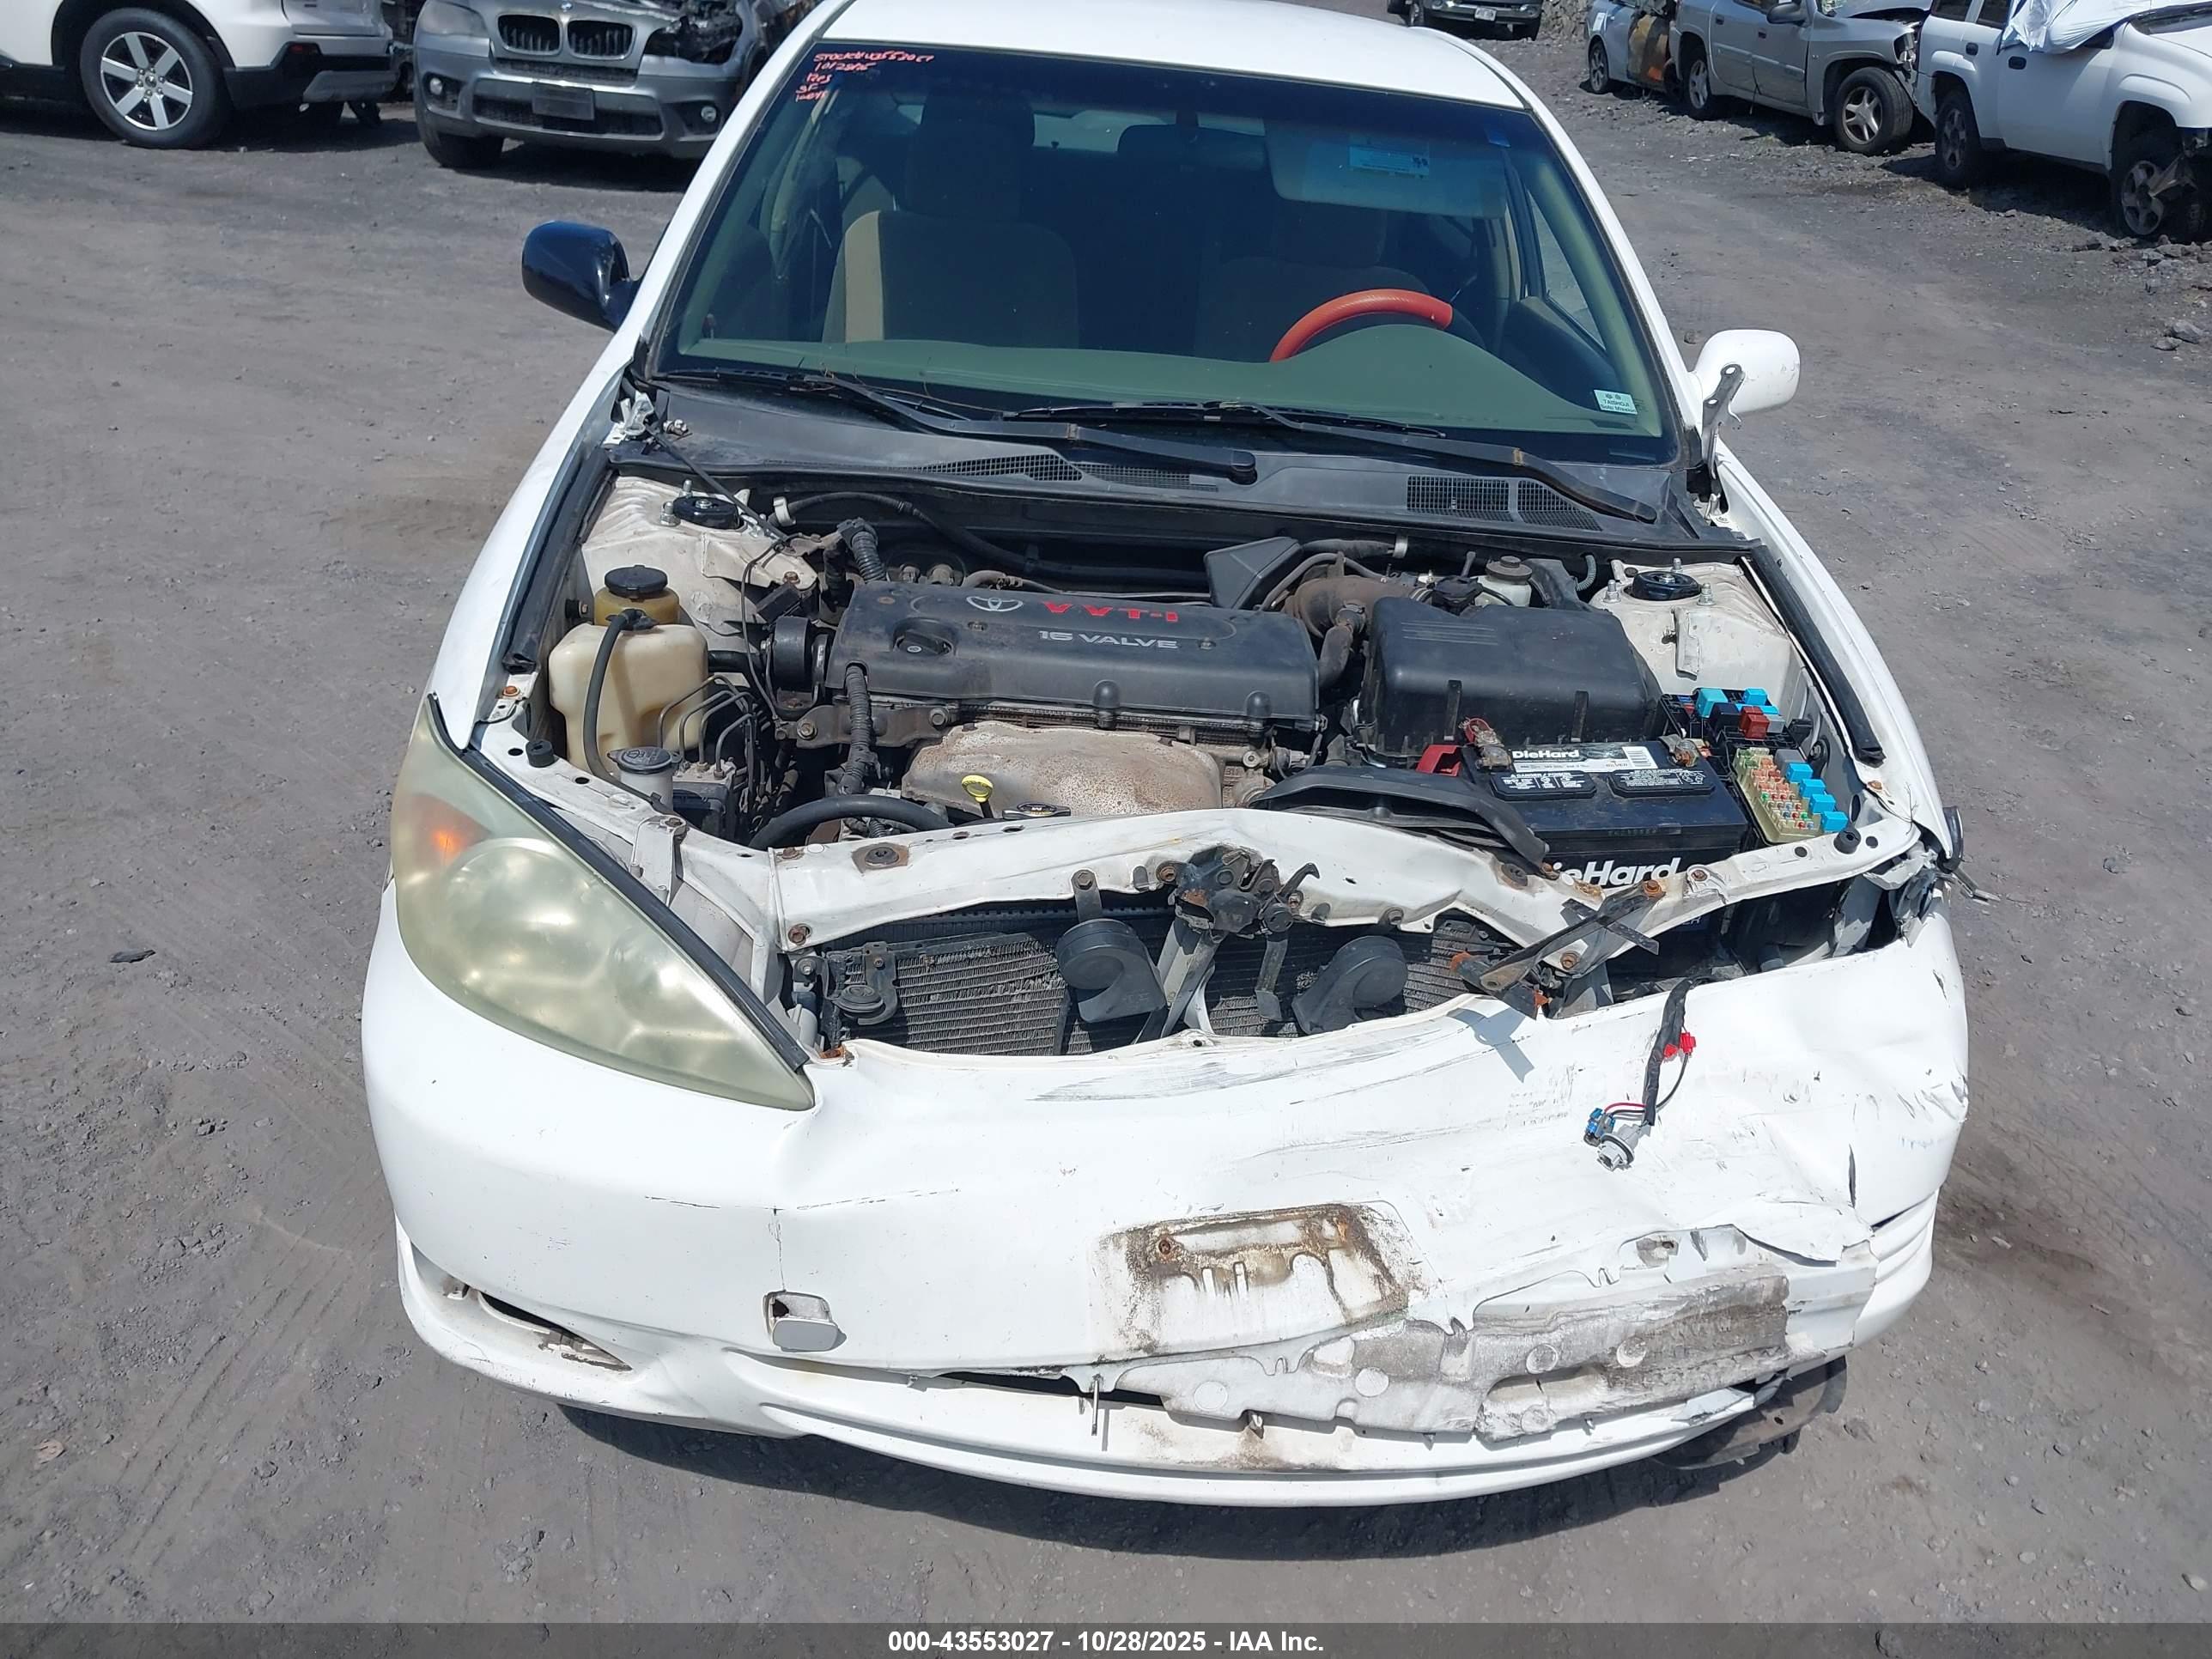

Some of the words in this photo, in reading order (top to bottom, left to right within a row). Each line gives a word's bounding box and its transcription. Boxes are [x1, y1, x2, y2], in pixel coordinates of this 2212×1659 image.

[1038, 631, 1073, 641] 16
[1079, 634, 1179, 649] VALVE
[1511, 749, 1580, 759] DieHard
